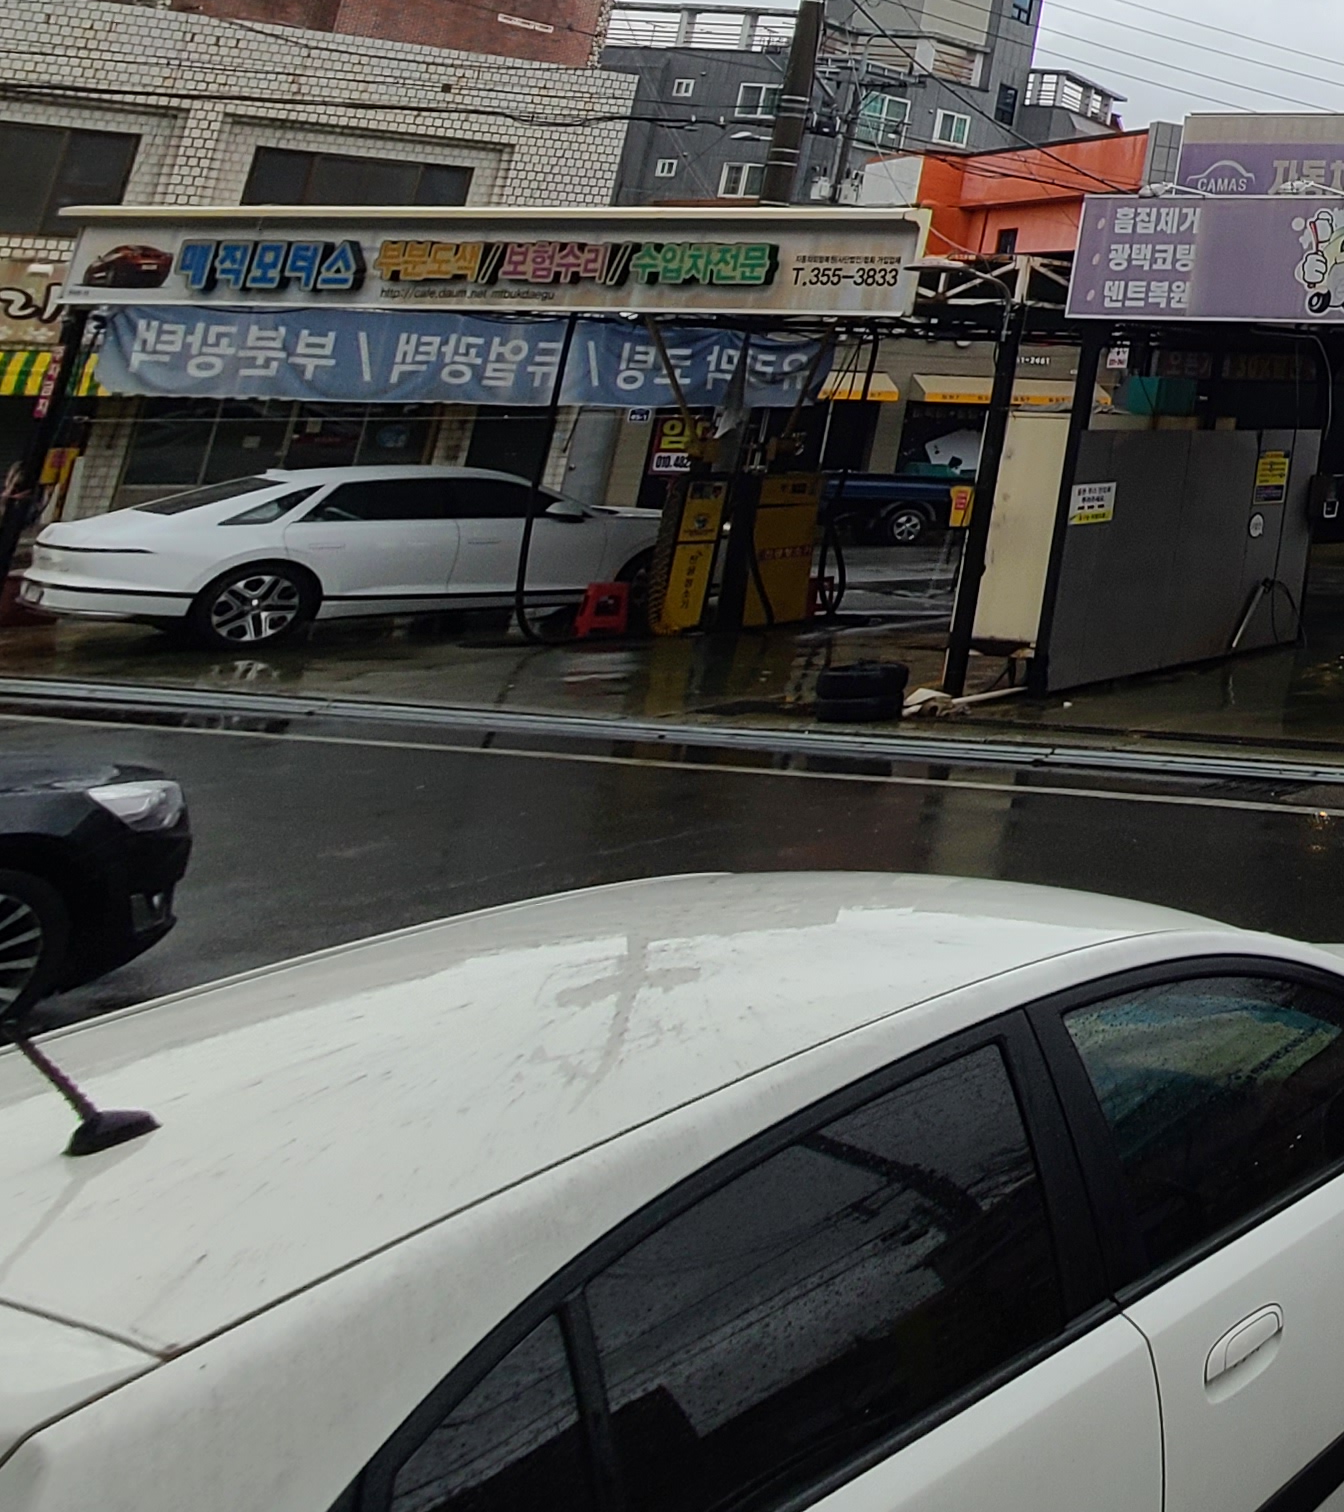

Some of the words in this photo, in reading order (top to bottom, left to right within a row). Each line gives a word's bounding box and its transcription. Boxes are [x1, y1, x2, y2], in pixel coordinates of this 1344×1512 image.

[1198, 178, 1247, 192] CAMAS
[1114, 207, 1200, 234] 흠집제거
[177, 240, 360, 291] 매직모터스
[1108, 244, 1197, 271] 광택코팅
[792, 267, 899, 287] T.355-3833
[1103, 280, 1192, 308] 덴트복원
